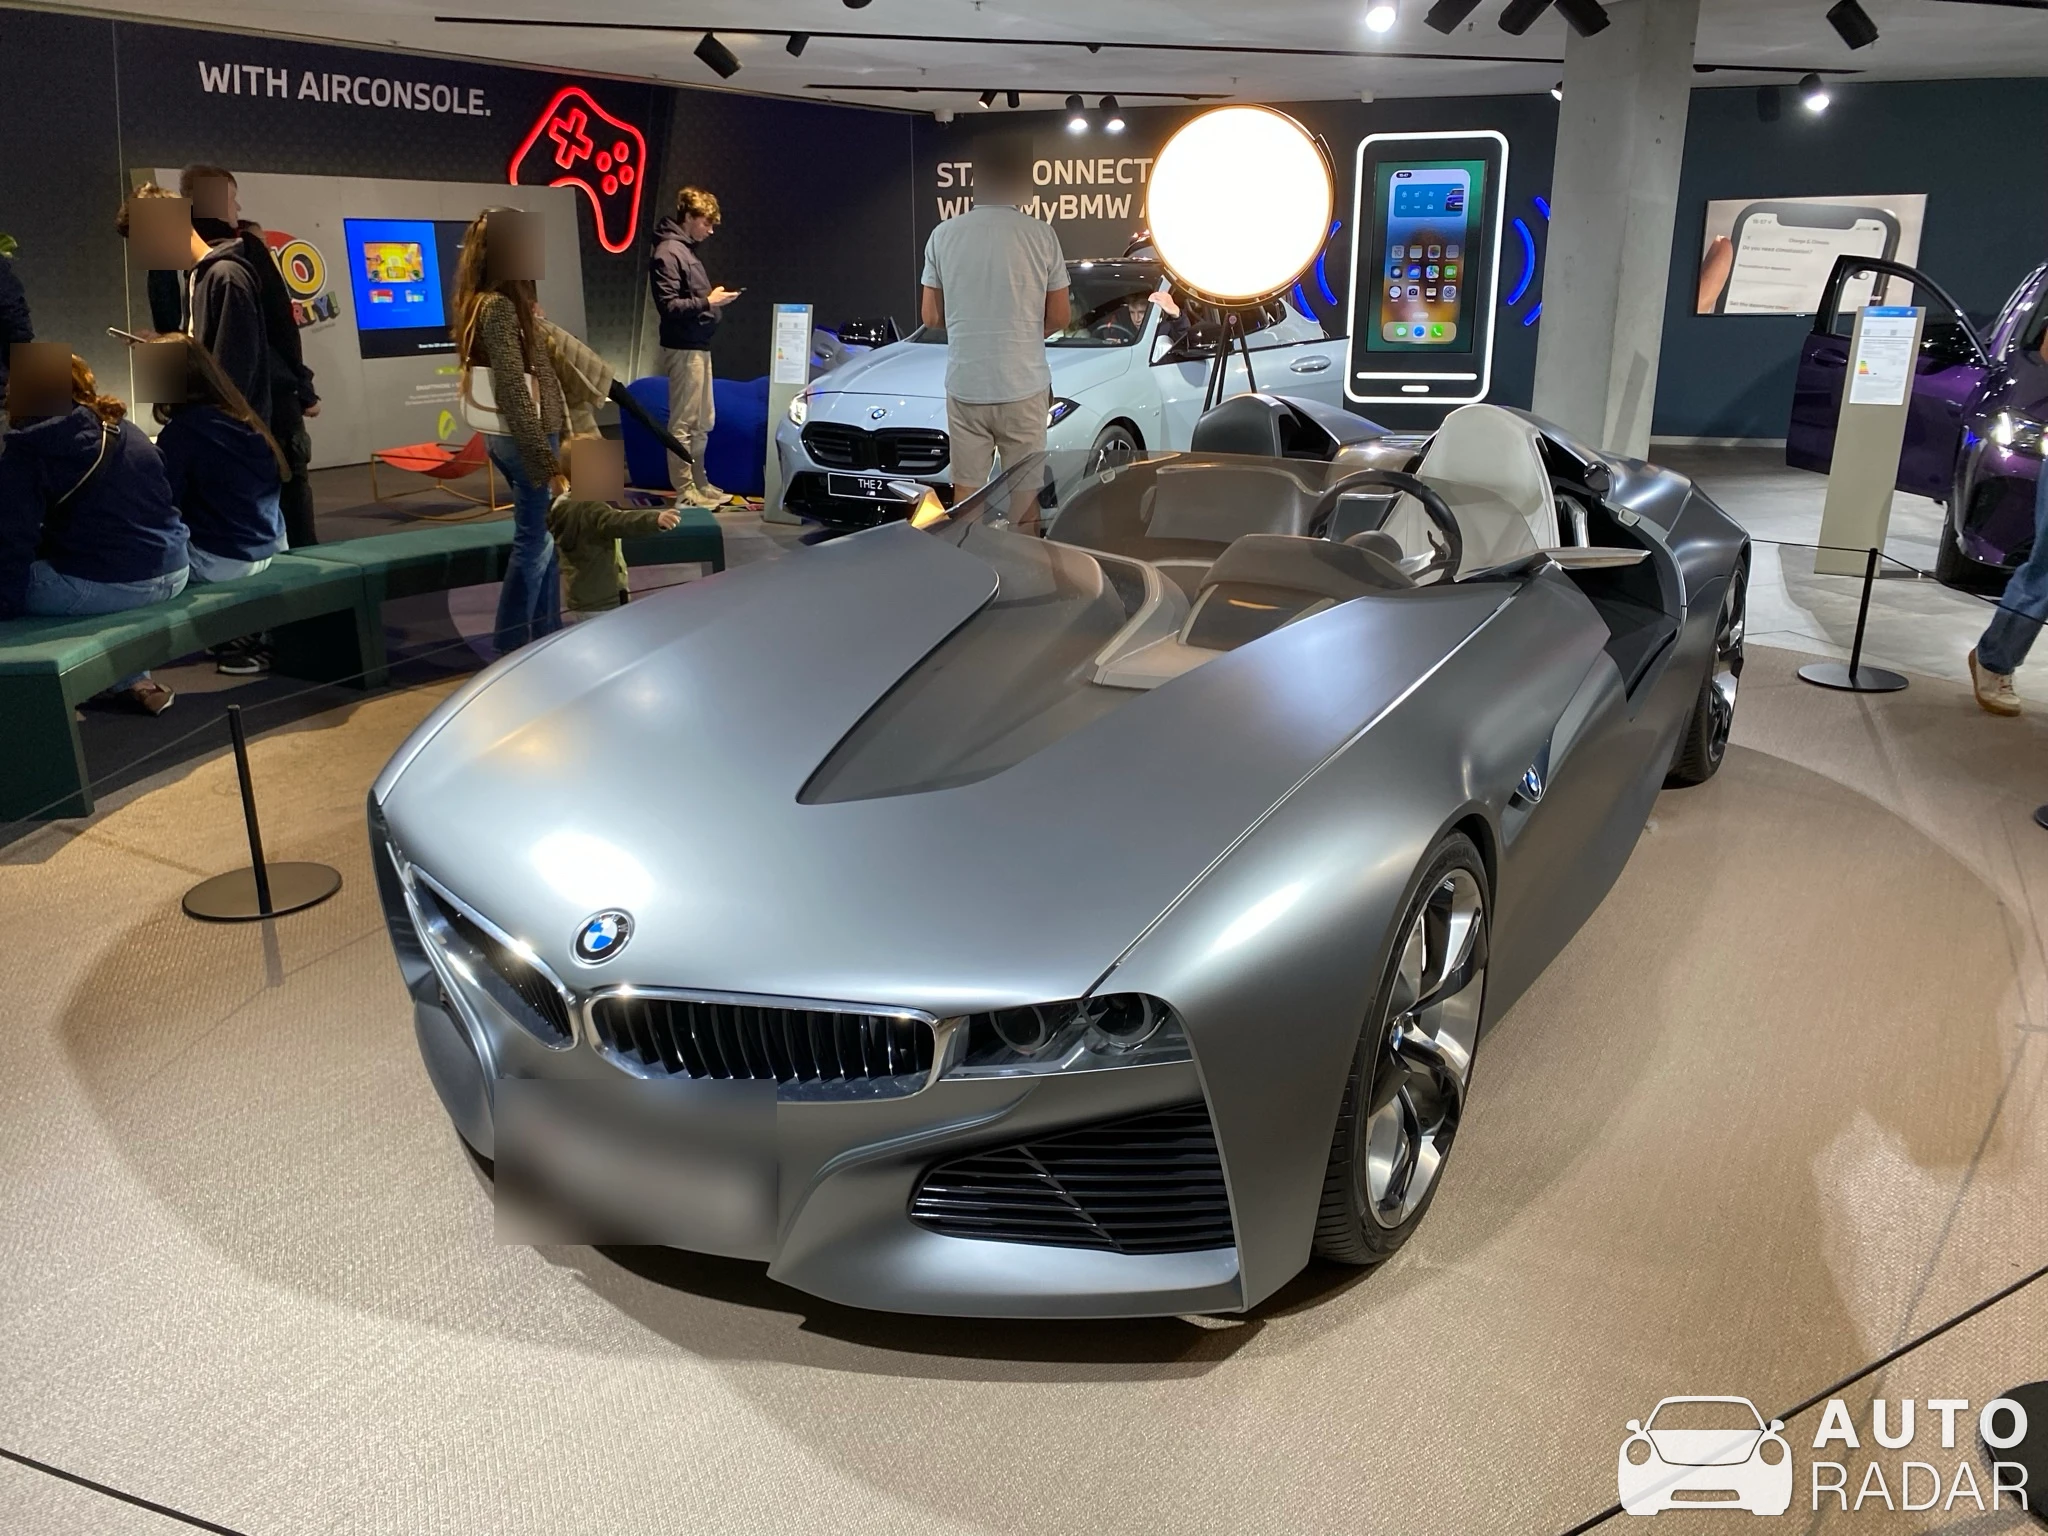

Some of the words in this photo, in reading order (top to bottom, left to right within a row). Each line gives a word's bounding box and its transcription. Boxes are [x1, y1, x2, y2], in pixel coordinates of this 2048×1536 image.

[198, 61, 288, 98] WITH
[297, 71, 492, 117] AIRCONSOLE.
[936, 162, 974, 188] ST
[1032, 158, 1154, 185] ONNECT
[936, 196, 974, 221] WI
[291, 291, 340, 326] RTY!
[857, 478, 876, 490] THE
[877, 480, 883, 490] 2
